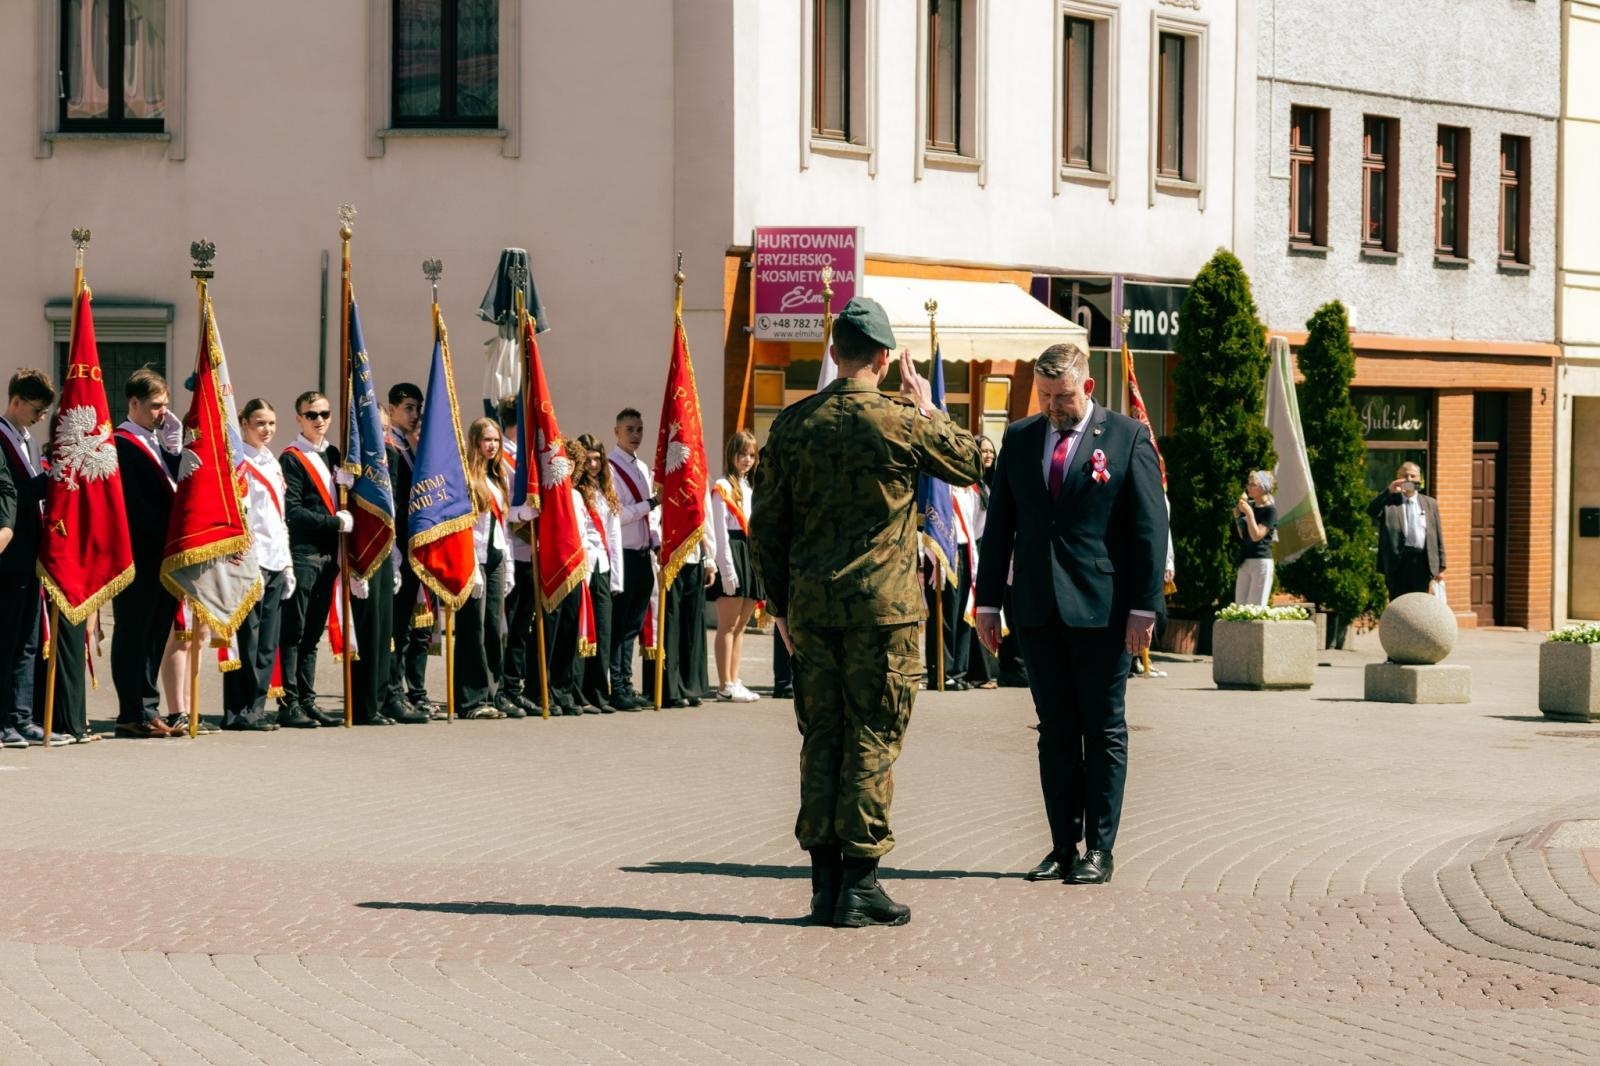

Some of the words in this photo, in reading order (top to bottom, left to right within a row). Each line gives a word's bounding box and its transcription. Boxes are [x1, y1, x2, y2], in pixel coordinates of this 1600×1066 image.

[757, 234, 855, 248] HURTOWNIA
[757, 253, 837, 266] FRYZJERSKO-
[757, 270, 855, 283] -KOSMETYZNA
[773, 318, 790, 329] +48
[793, 318, 810, 329] 782
[1540, 387, 1547, 406] 5
[1361, 400, 1422, 436] Jubiler
